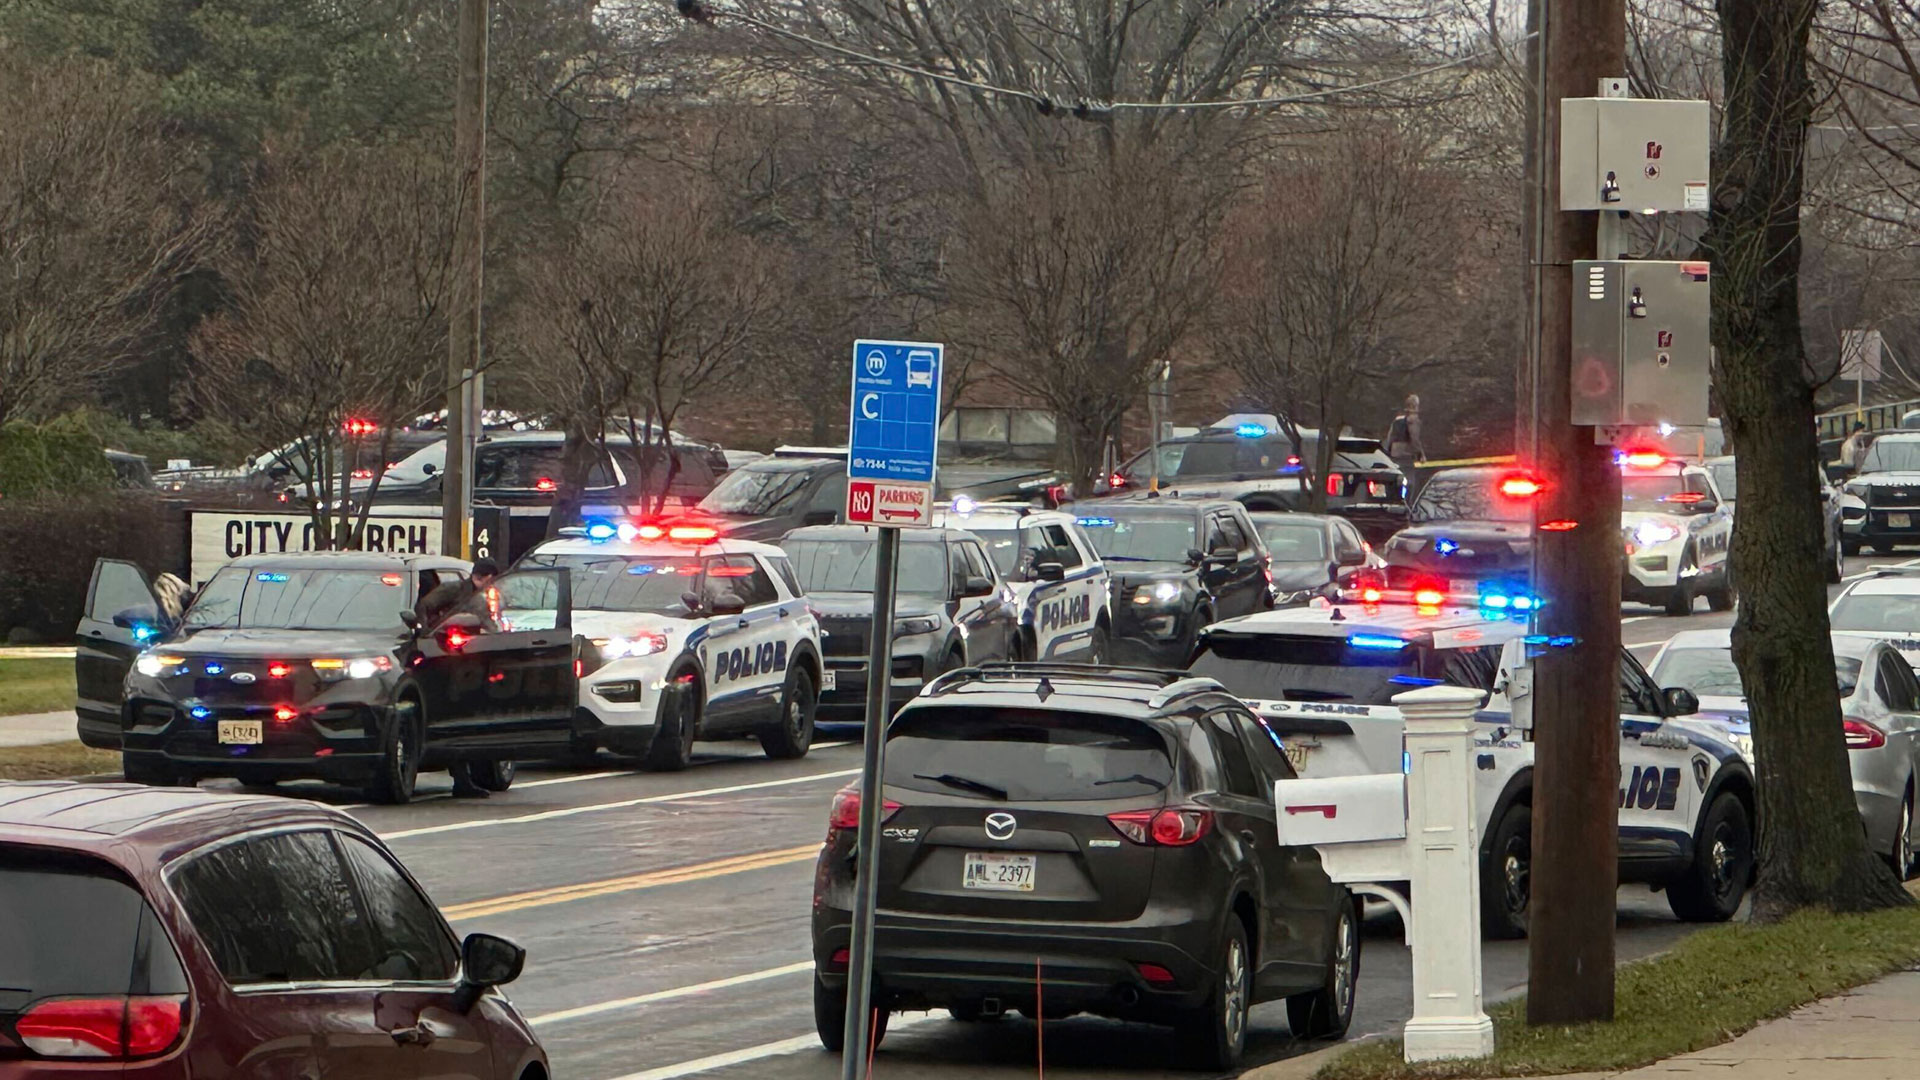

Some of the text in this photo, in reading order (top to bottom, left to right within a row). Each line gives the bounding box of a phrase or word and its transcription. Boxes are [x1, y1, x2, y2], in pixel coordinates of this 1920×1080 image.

[861, 392, 879, 419] C
[852, 489, 925, 514] NO PARKING
[225, 520, 292, 558] CITY
[1041, 594, 1090, 633] POLICE
[714, 640, 787, 684] POLICE
